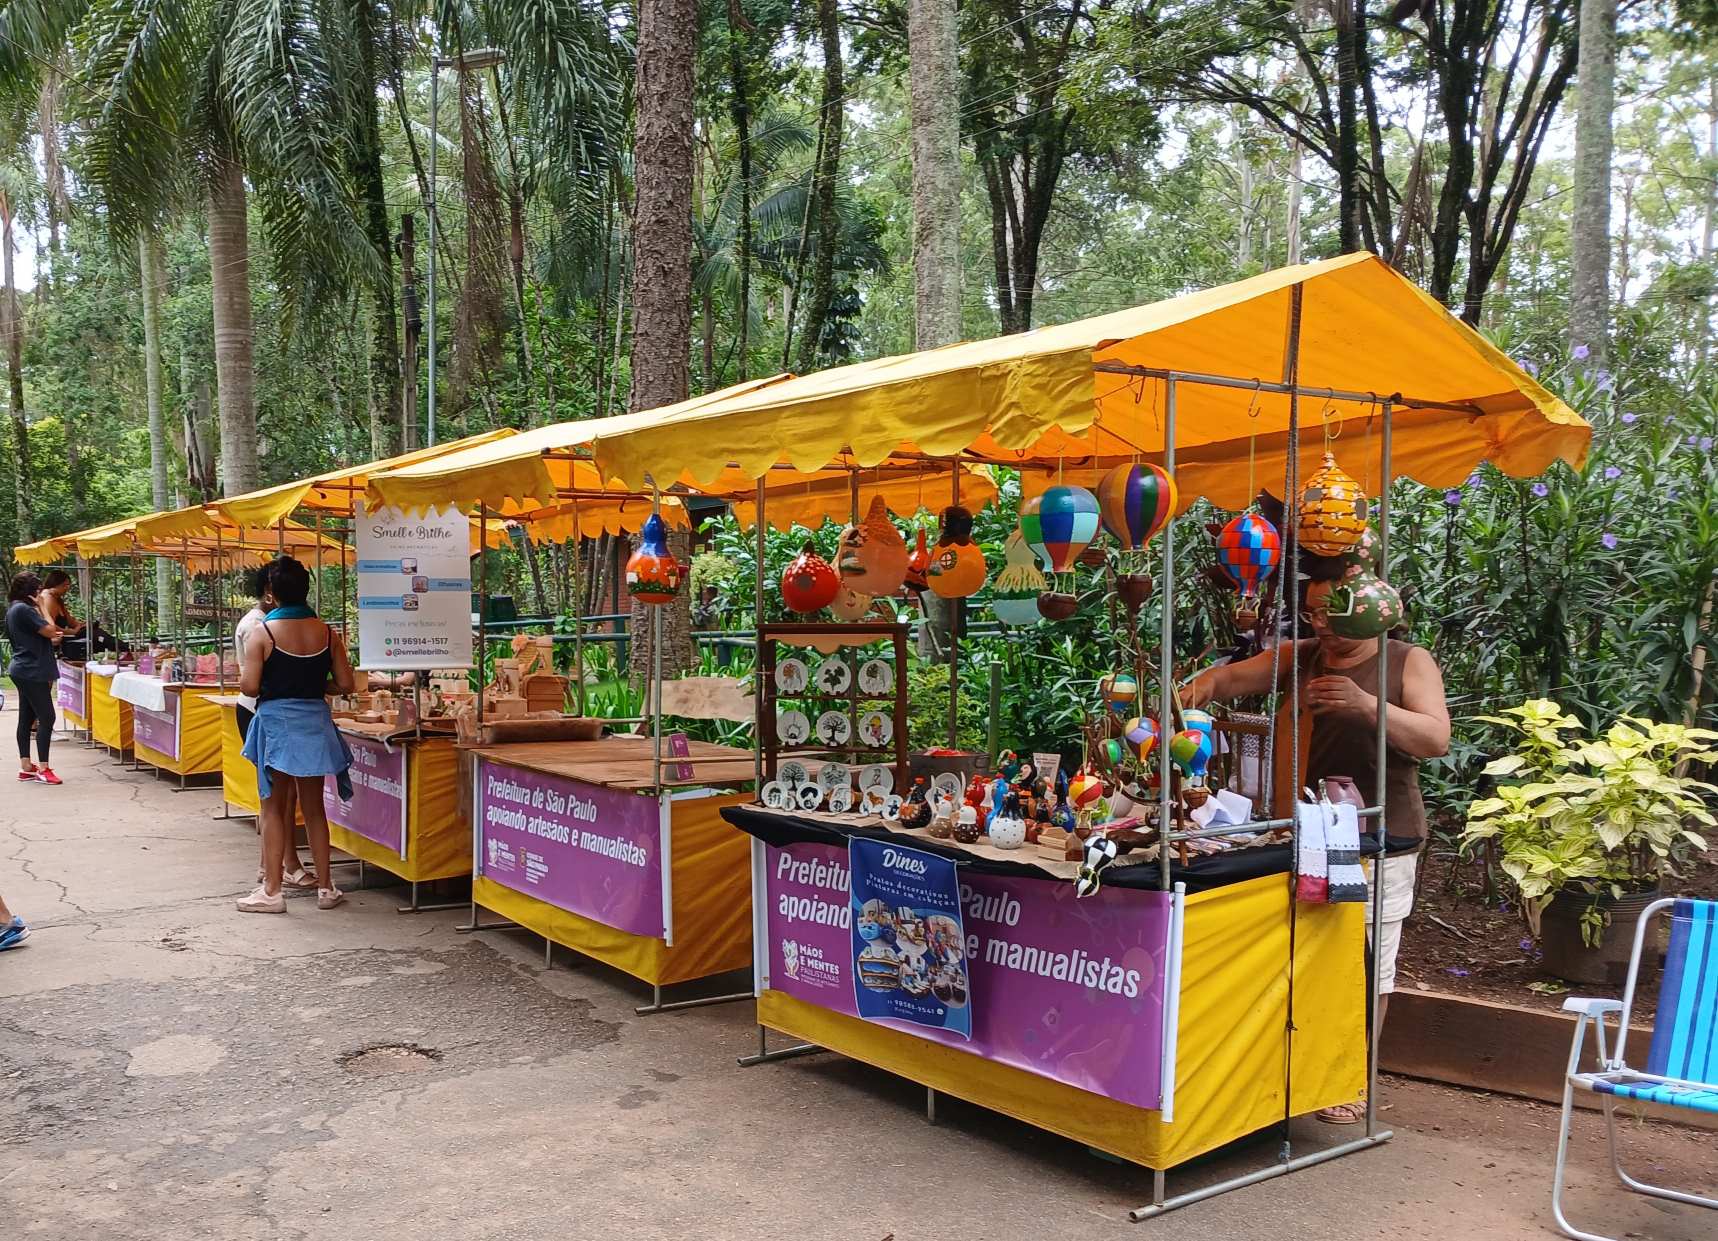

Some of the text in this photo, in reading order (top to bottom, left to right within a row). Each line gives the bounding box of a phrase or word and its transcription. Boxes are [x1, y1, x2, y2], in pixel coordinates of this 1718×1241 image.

[372, 525, 407, 538] Smell
[416, 525, 453, 540] Brilho
[487, 775, 597, 823] Prefeitura de São Paulo
[486, 805, 527, 831] apoiando
[528, 816, 569, 844] artesãos
[571, 829, 579, 846] e
[580, 831, 647, 867] manualistas
[882, 848, 928, 875] Dines
[777, 852, 1021, 926] Prefeitu Paulo
[779, 894, 1141, 998] apoiand e manualistas
[807, 957, 840, 975] MENTES
